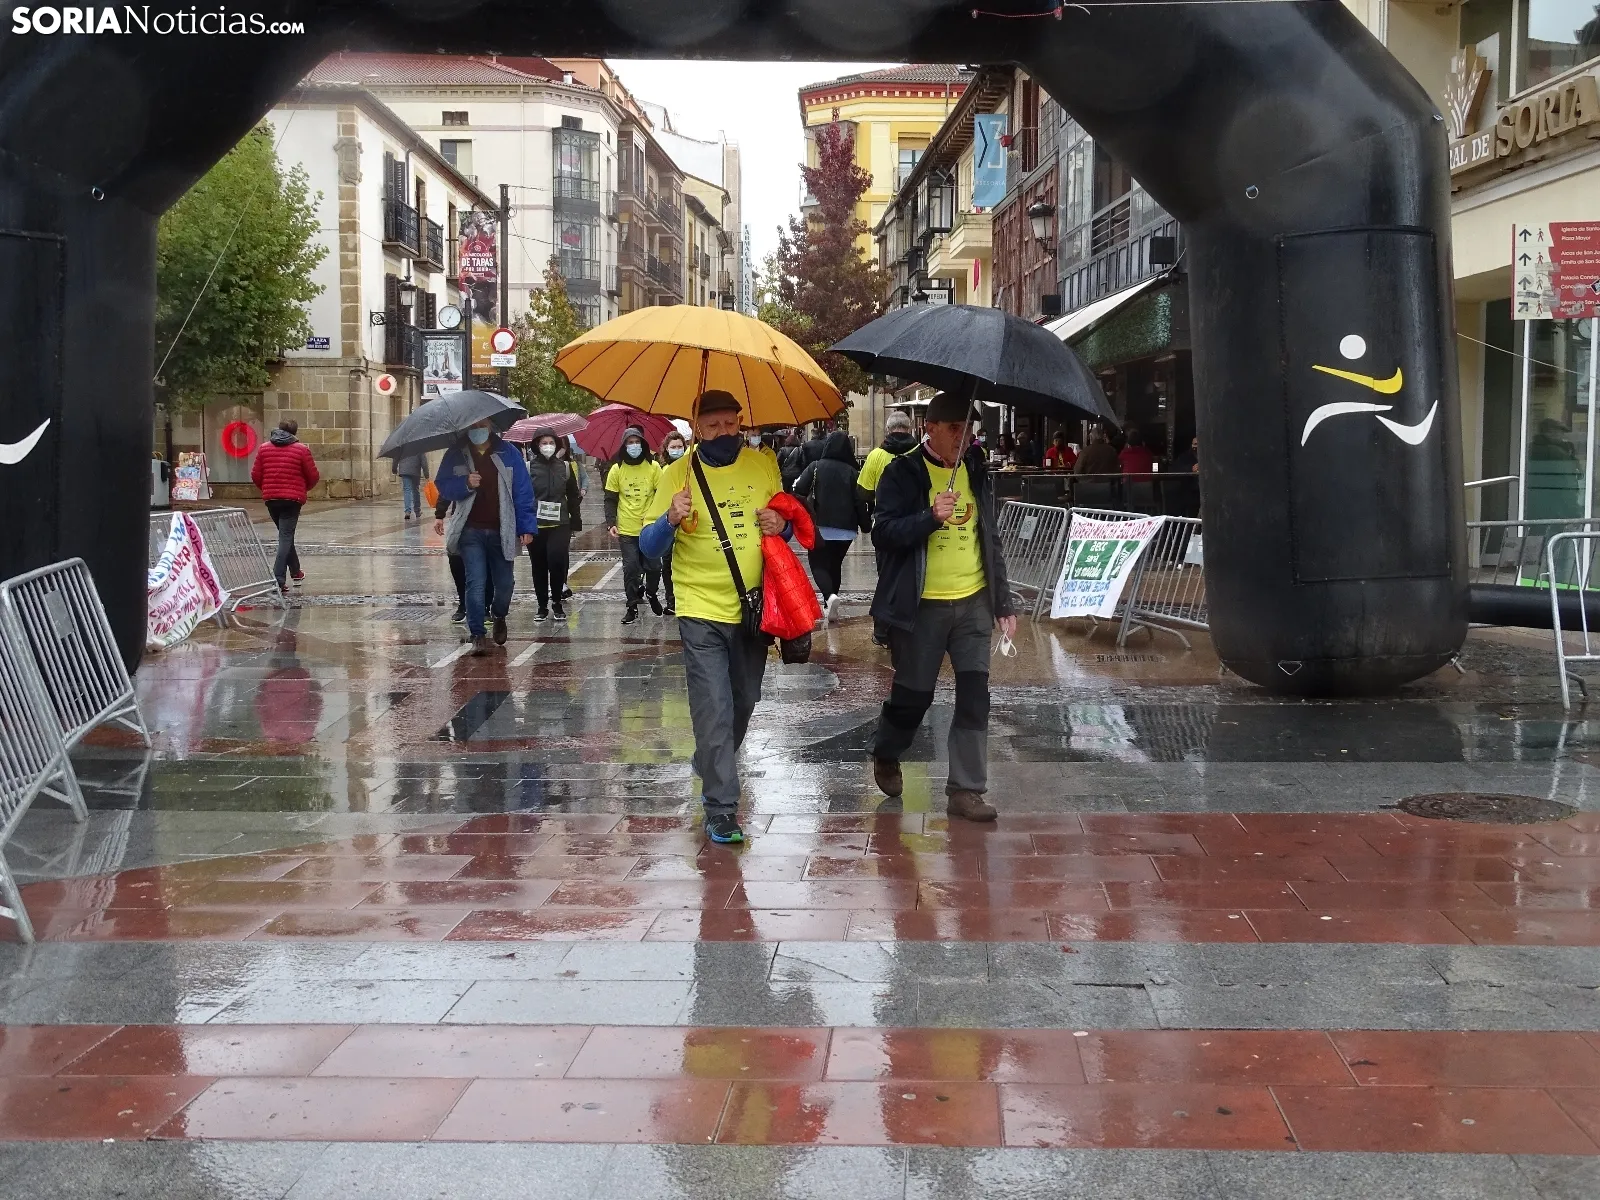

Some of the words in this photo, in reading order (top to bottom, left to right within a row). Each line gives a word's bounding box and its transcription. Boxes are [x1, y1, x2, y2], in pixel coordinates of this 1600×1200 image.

[1472, 134, 1490, 161] DE
[1496, 76, 1600, 158] SORIA
[461, 258, 470, 266] DE
[472, 258, 493, 266] TAPAS
